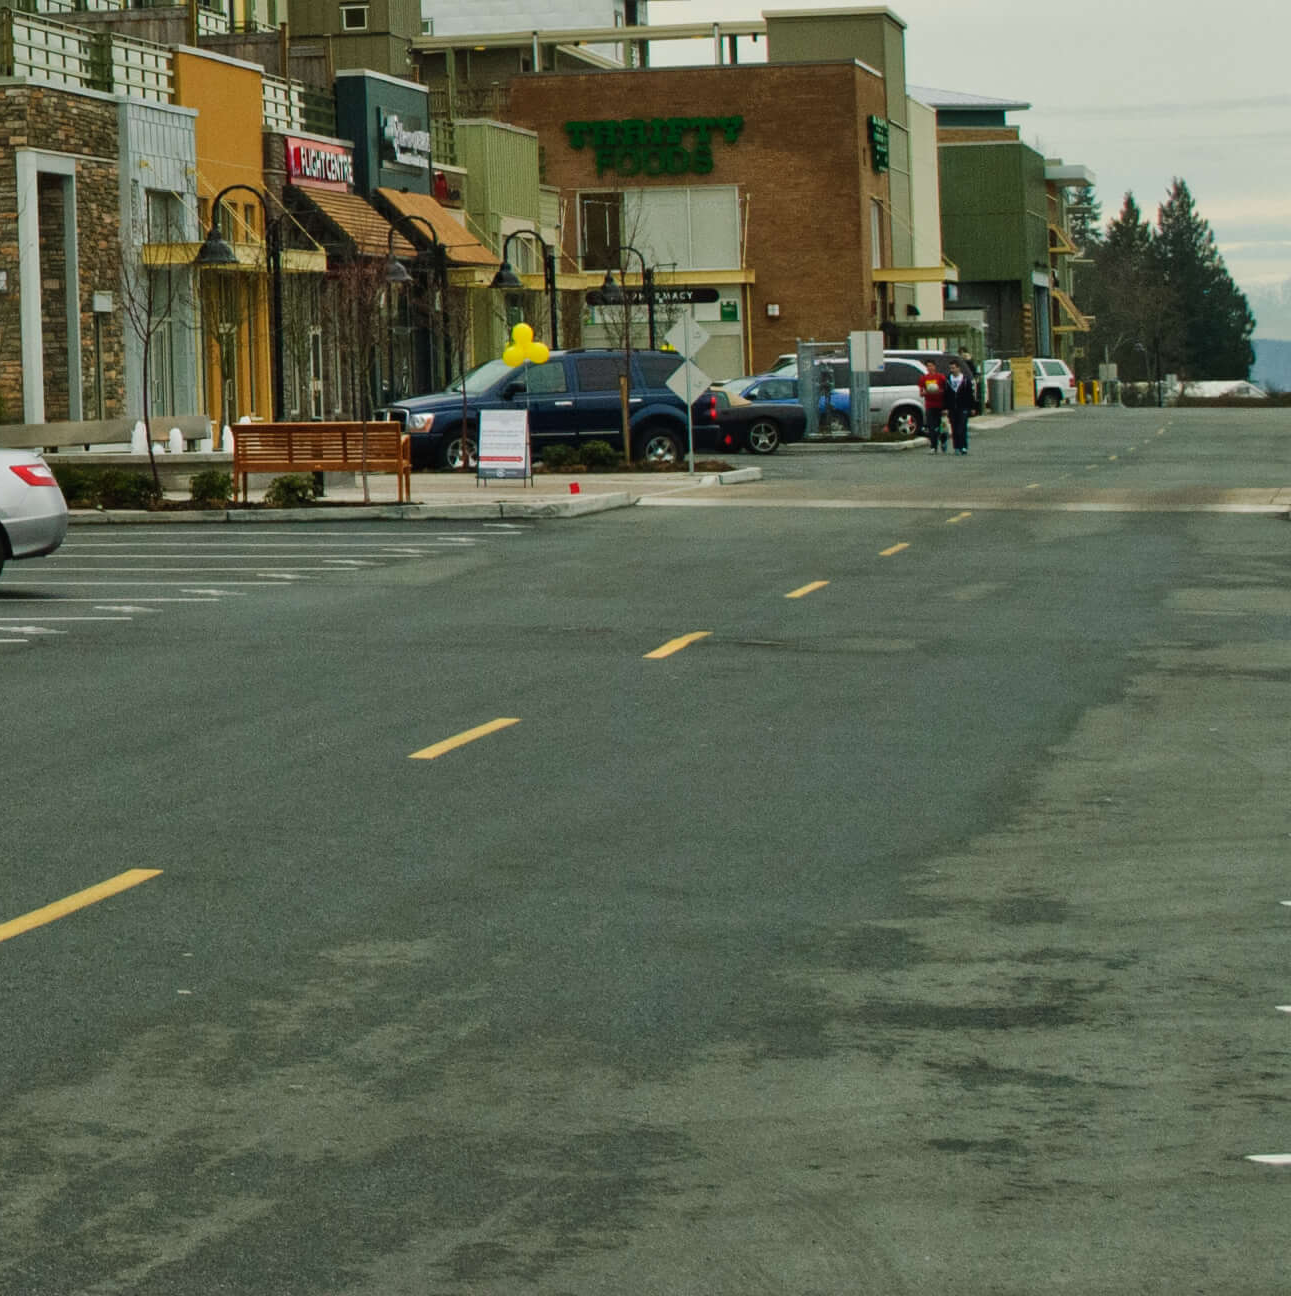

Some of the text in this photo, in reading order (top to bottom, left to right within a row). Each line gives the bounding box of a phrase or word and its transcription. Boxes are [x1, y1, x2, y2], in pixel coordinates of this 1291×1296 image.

[564, 115, 744, 151] THRIFTY
[300, 146, 354, 184] FLIGHT CENTRE
[595, 146, 714, 179] FOODS
